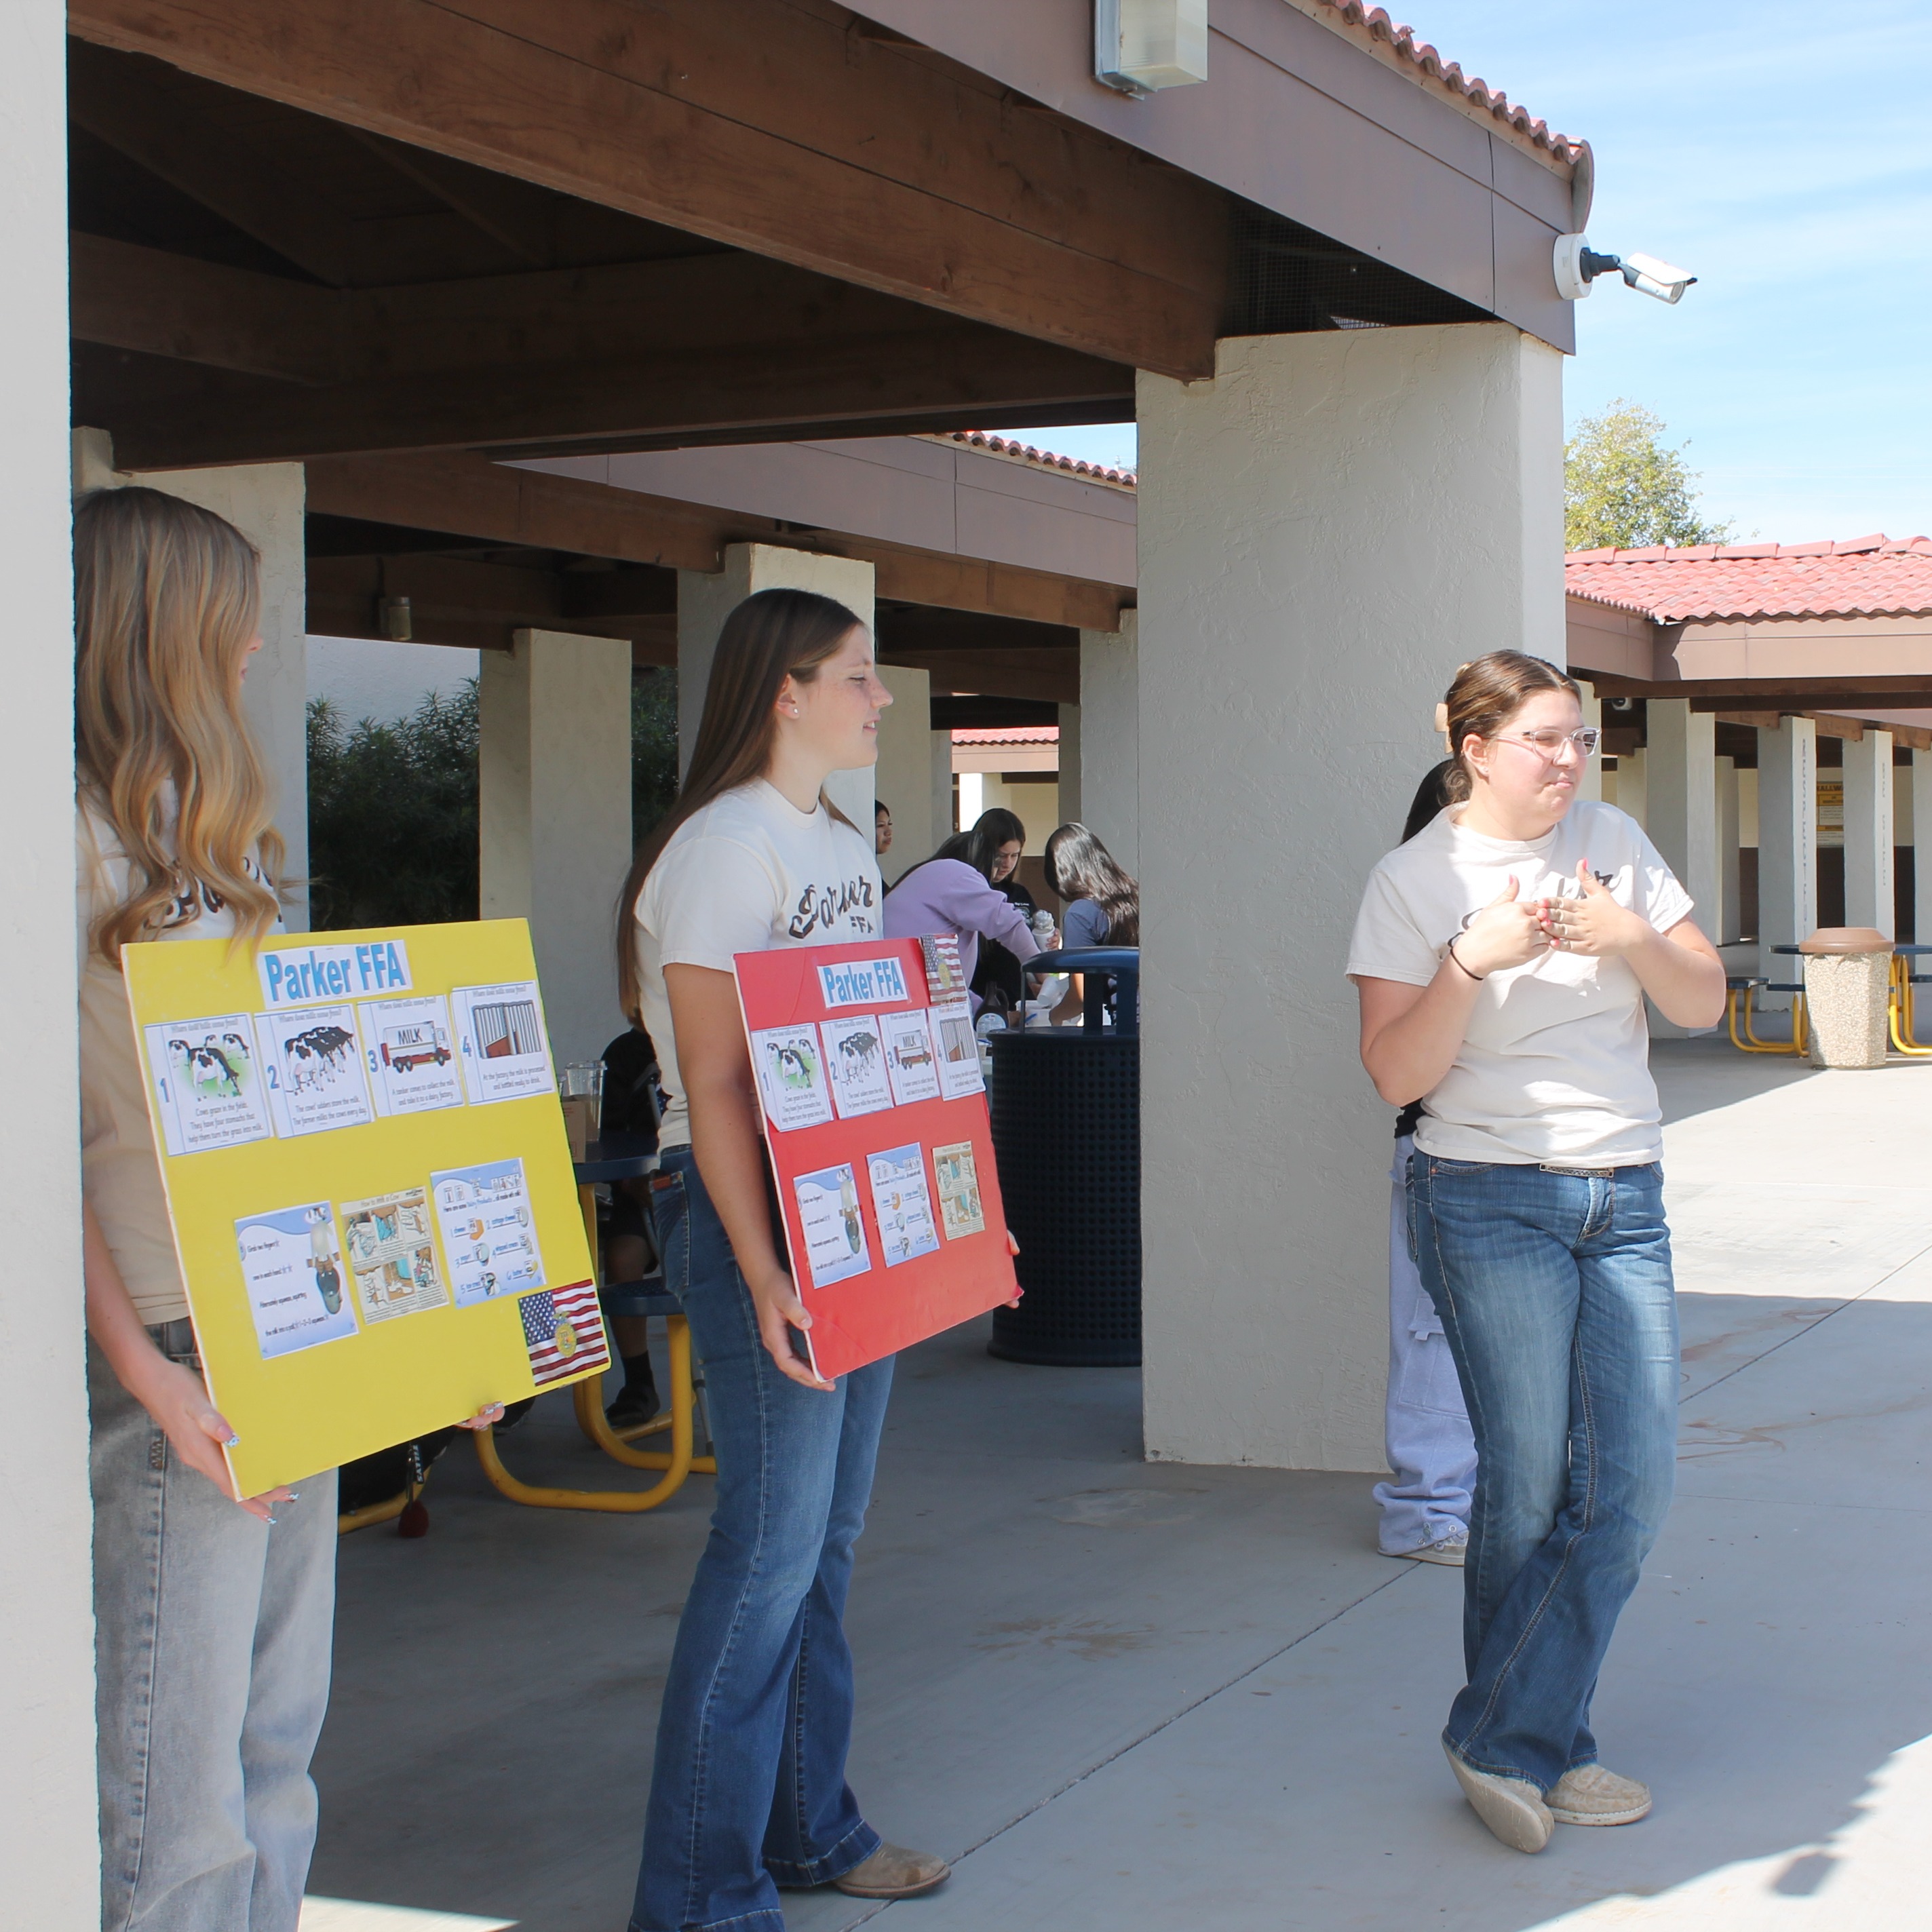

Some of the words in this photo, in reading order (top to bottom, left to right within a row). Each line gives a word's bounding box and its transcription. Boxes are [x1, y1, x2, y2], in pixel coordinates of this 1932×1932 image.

[265, 950, 351, 1001] Parker
[355, 942, 406, 990] FFA
[823, 965, 874, 1003] Parker
[873, 961, 904, 997] FFA
[398, 1028, 423, 1045] MILK
[463, 1035, 471, 1058] 4
[902, 1035, 916, 1048] MILK
[368, 1049, 378, 1073] 3
[830, 1061, 838, 1080] 2
[887, 1051, 894, 1069] 3
[267, 1065, 279, 1089] 2
[762, 1072, 769, 1091] 1
[160, 1078, 170, 1102] 1
